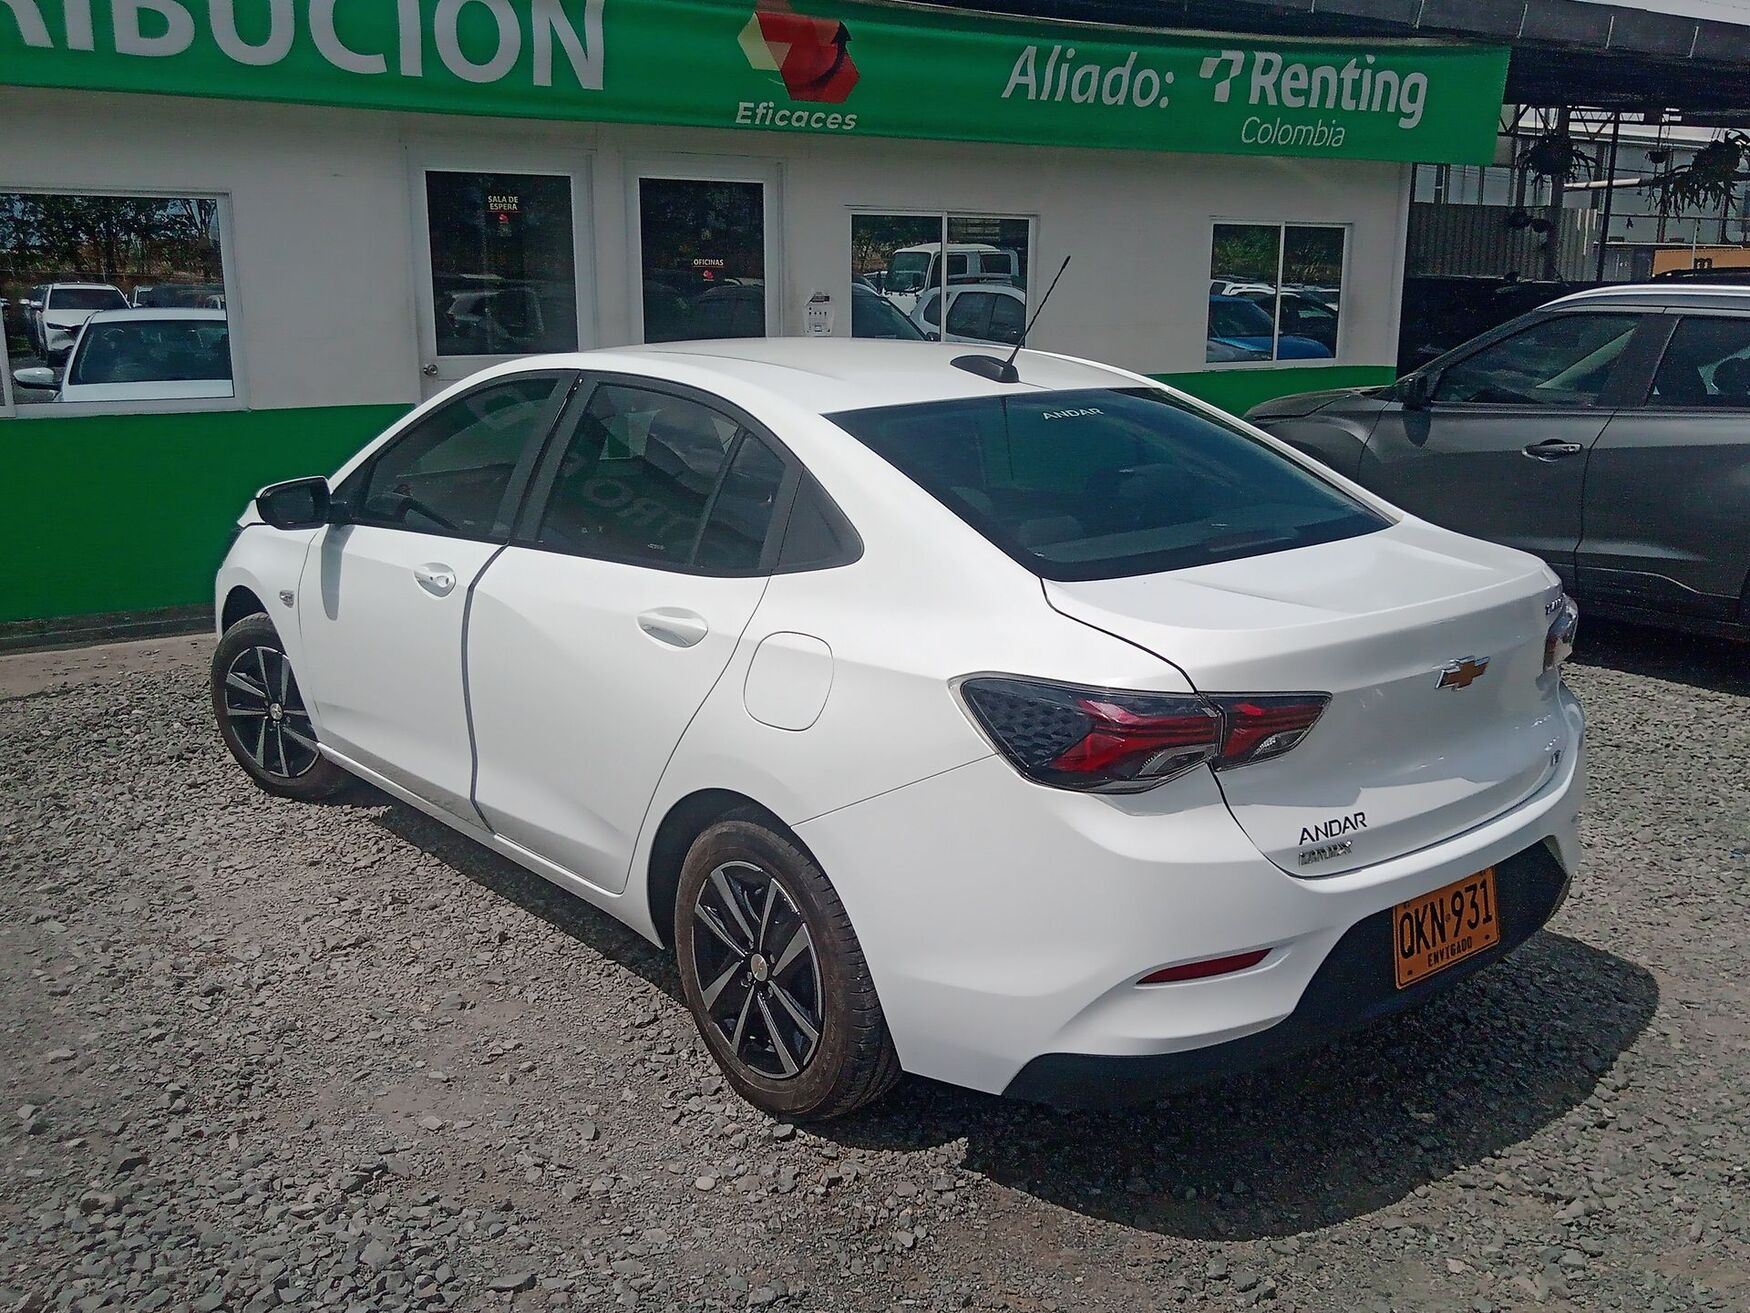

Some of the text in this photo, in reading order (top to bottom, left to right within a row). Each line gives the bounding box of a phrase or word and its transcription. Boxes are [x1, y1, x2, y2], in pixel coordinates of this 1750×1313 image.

[1001, 44, 1428, 129] Aliado: Renting
[735, 101, 858, 130] Eficaces
[1241, 116, 1345, 147] Colombia
[487, 195, 507, 203] SALA
[693, 258, 724, 266] OFICINAS
[1042, 408, 1104, 419] ANDAR
[1299, 811, 1368, 846] ANDAR
